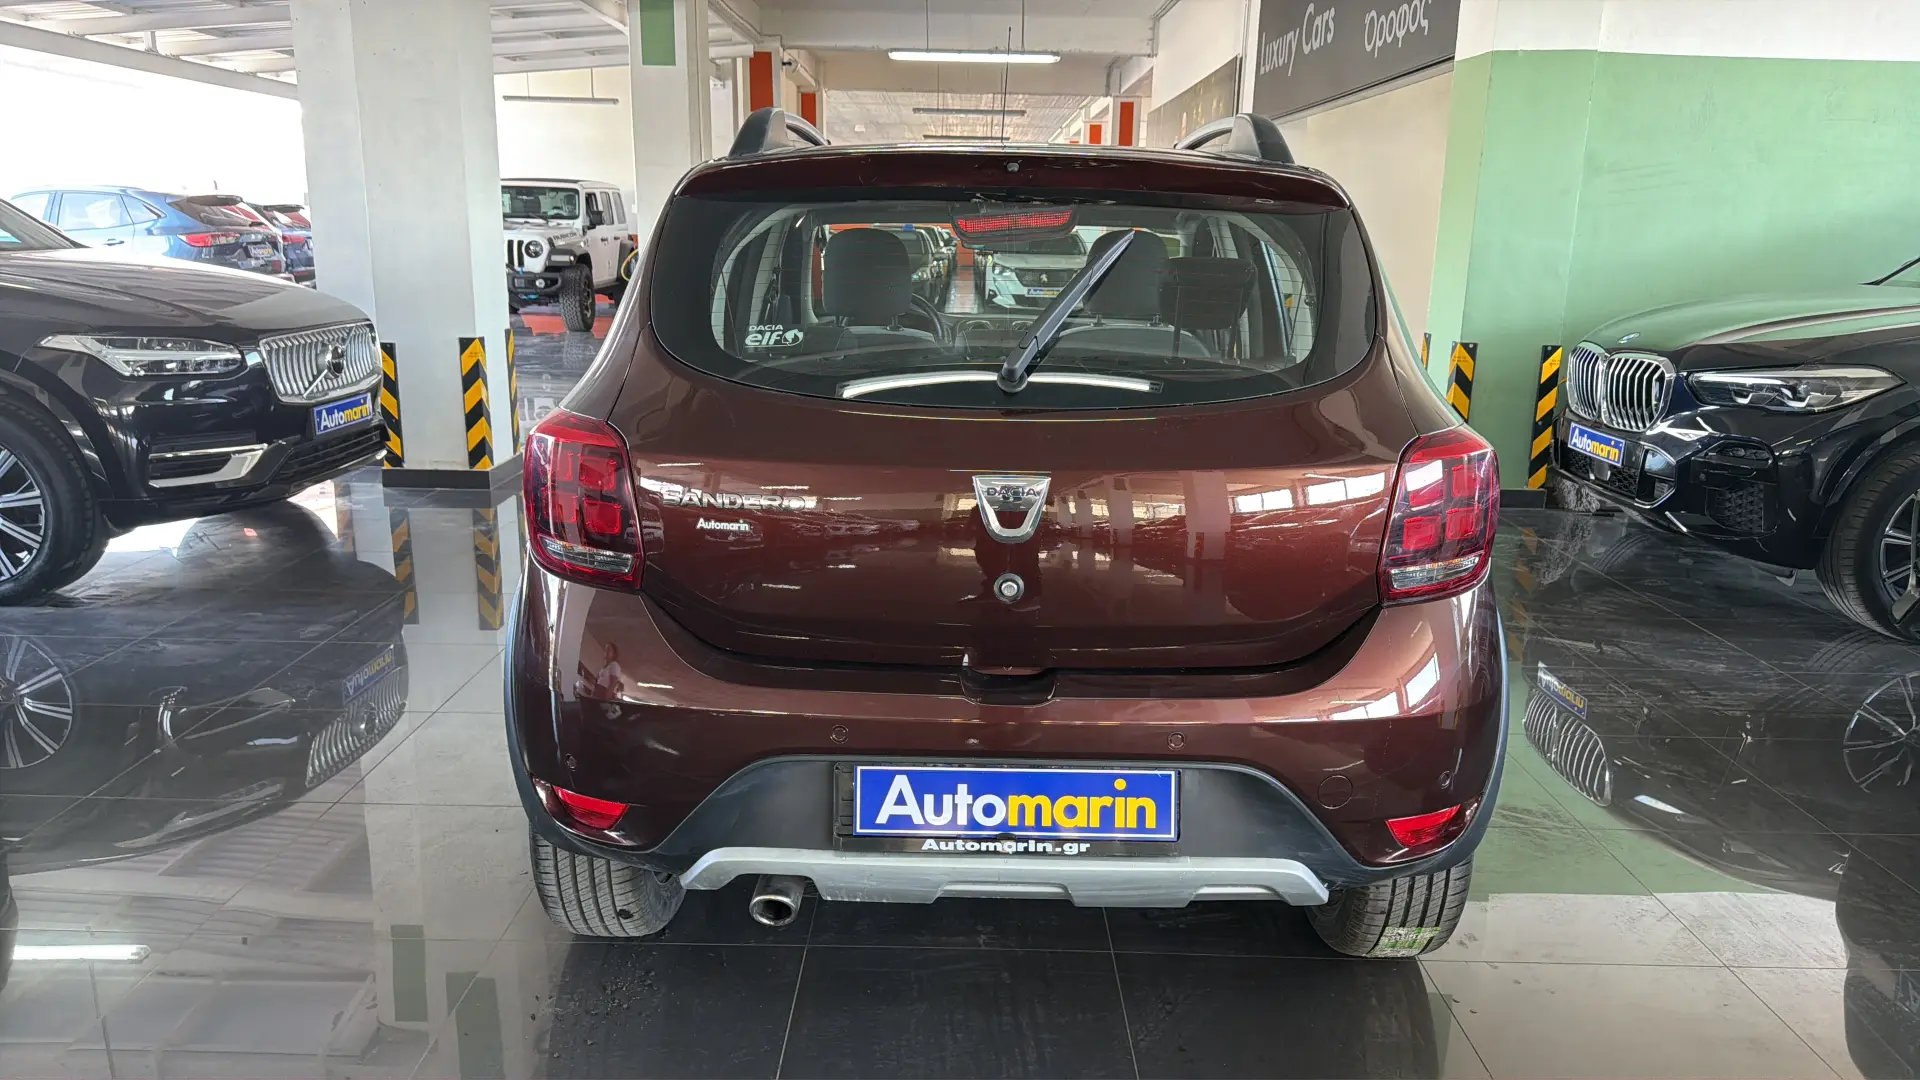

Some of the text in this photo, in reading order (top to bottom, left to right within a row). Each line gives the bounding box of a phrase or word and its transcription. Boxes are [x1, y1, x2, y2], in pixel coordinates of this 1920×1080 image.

[1260, 2, 1336, 77] Luxury Cars
[745, 331, 783, 346] elf
[320, 398, 370, 431] Automarin
[1571, 427, 1619, 462] Automarin
[661, 486, 806, 510] SANDERO
[986, 486, 1038, 497] DACIA
[696, 518, 749, 531] Automarin
[875, 774, 1157, 829] Automarin
[921, 838, 1091, 855] Automarin.gr
